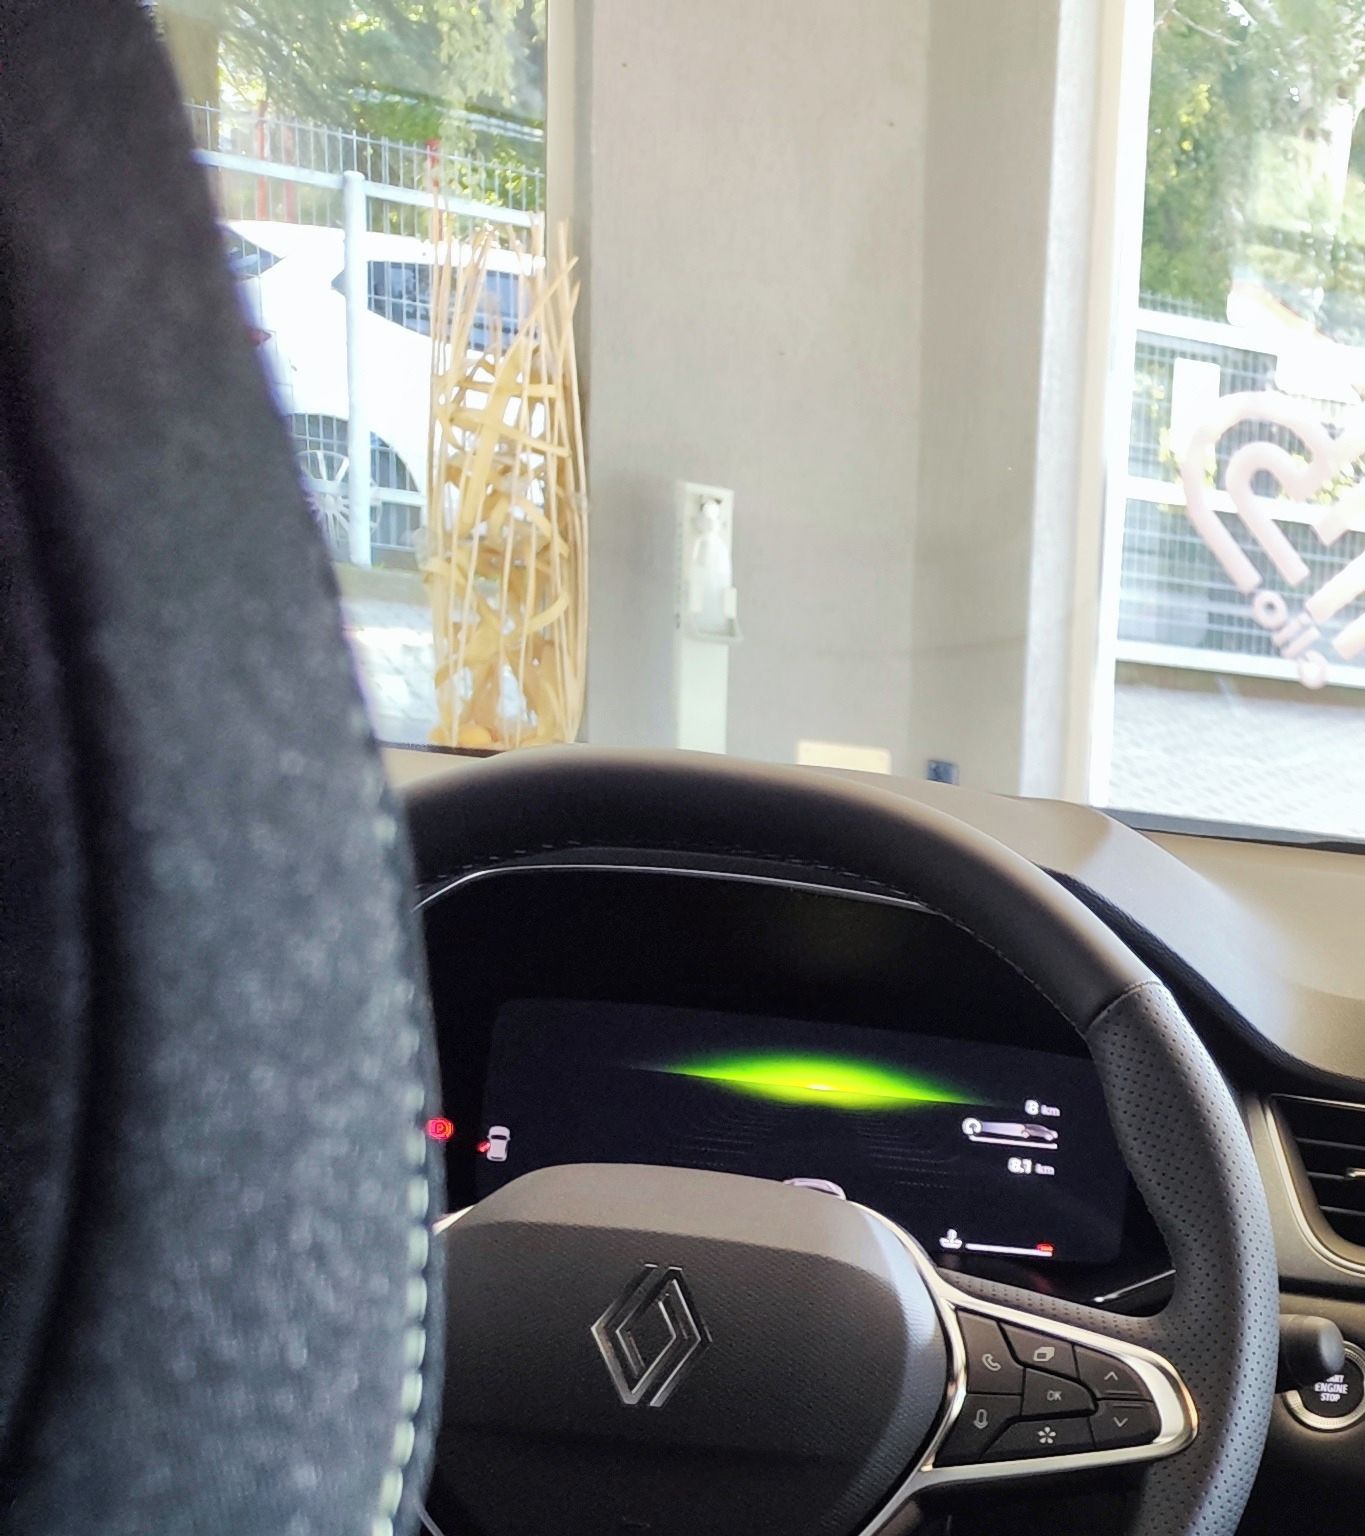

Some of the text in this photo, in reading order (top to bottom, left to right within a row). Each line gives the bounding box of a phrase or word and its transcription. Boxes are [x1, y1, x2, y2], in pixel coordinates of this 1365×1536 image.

[1041, 1104, 1060, 1116] km
[1035, 1163, 1055, 1175] km
[1314, 1382, 1349, 1395] ENGINE
[1046, 1389, 1062, 1401] OK
[1320, 1392, 1341, 1402] STOP
